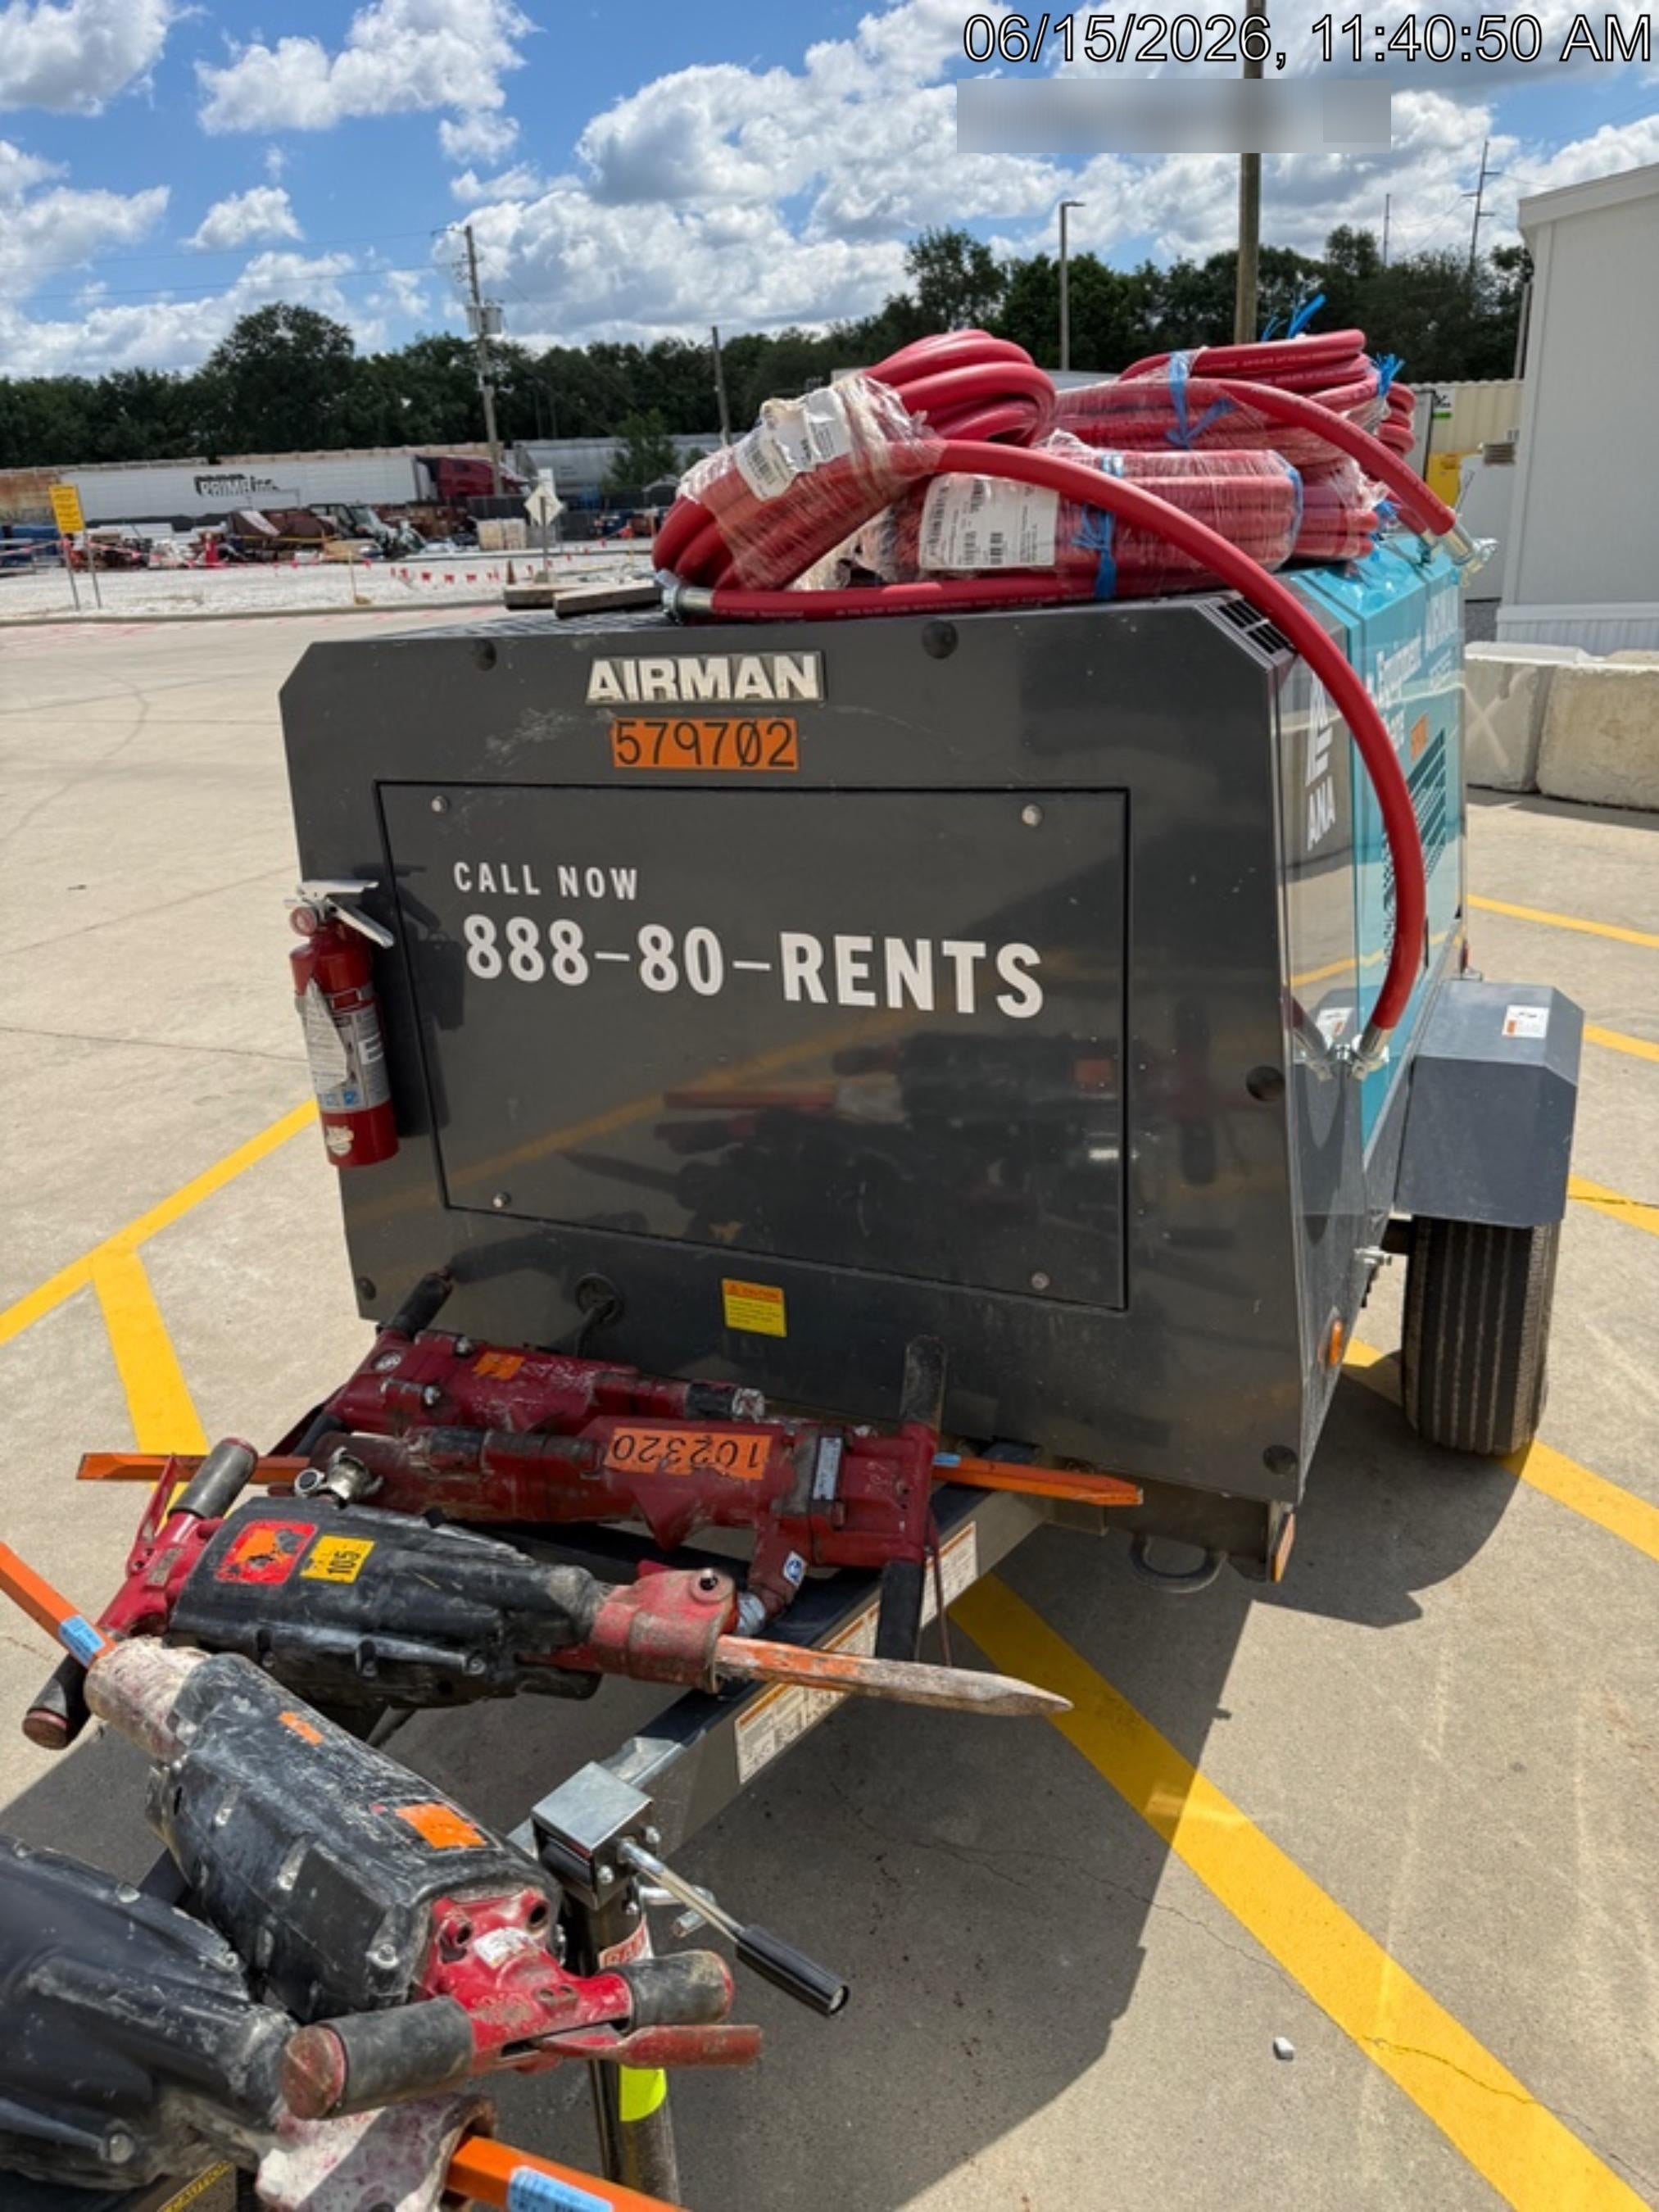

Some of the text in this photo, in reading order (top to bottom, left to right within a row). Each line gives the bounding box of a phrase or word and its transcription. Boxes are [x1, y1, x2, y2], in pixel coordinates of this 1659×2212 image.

[586, 654, 820, 702] AIRMAN
[614, 719, 795, 767] 579702
[453, 861, 637, 900] CALL NOW
[463, 913, 1044, 1018] 888-80-RENTS
[613, 1435, 759, 1469] 102320
[326, 1550, 360, 1574] 105
